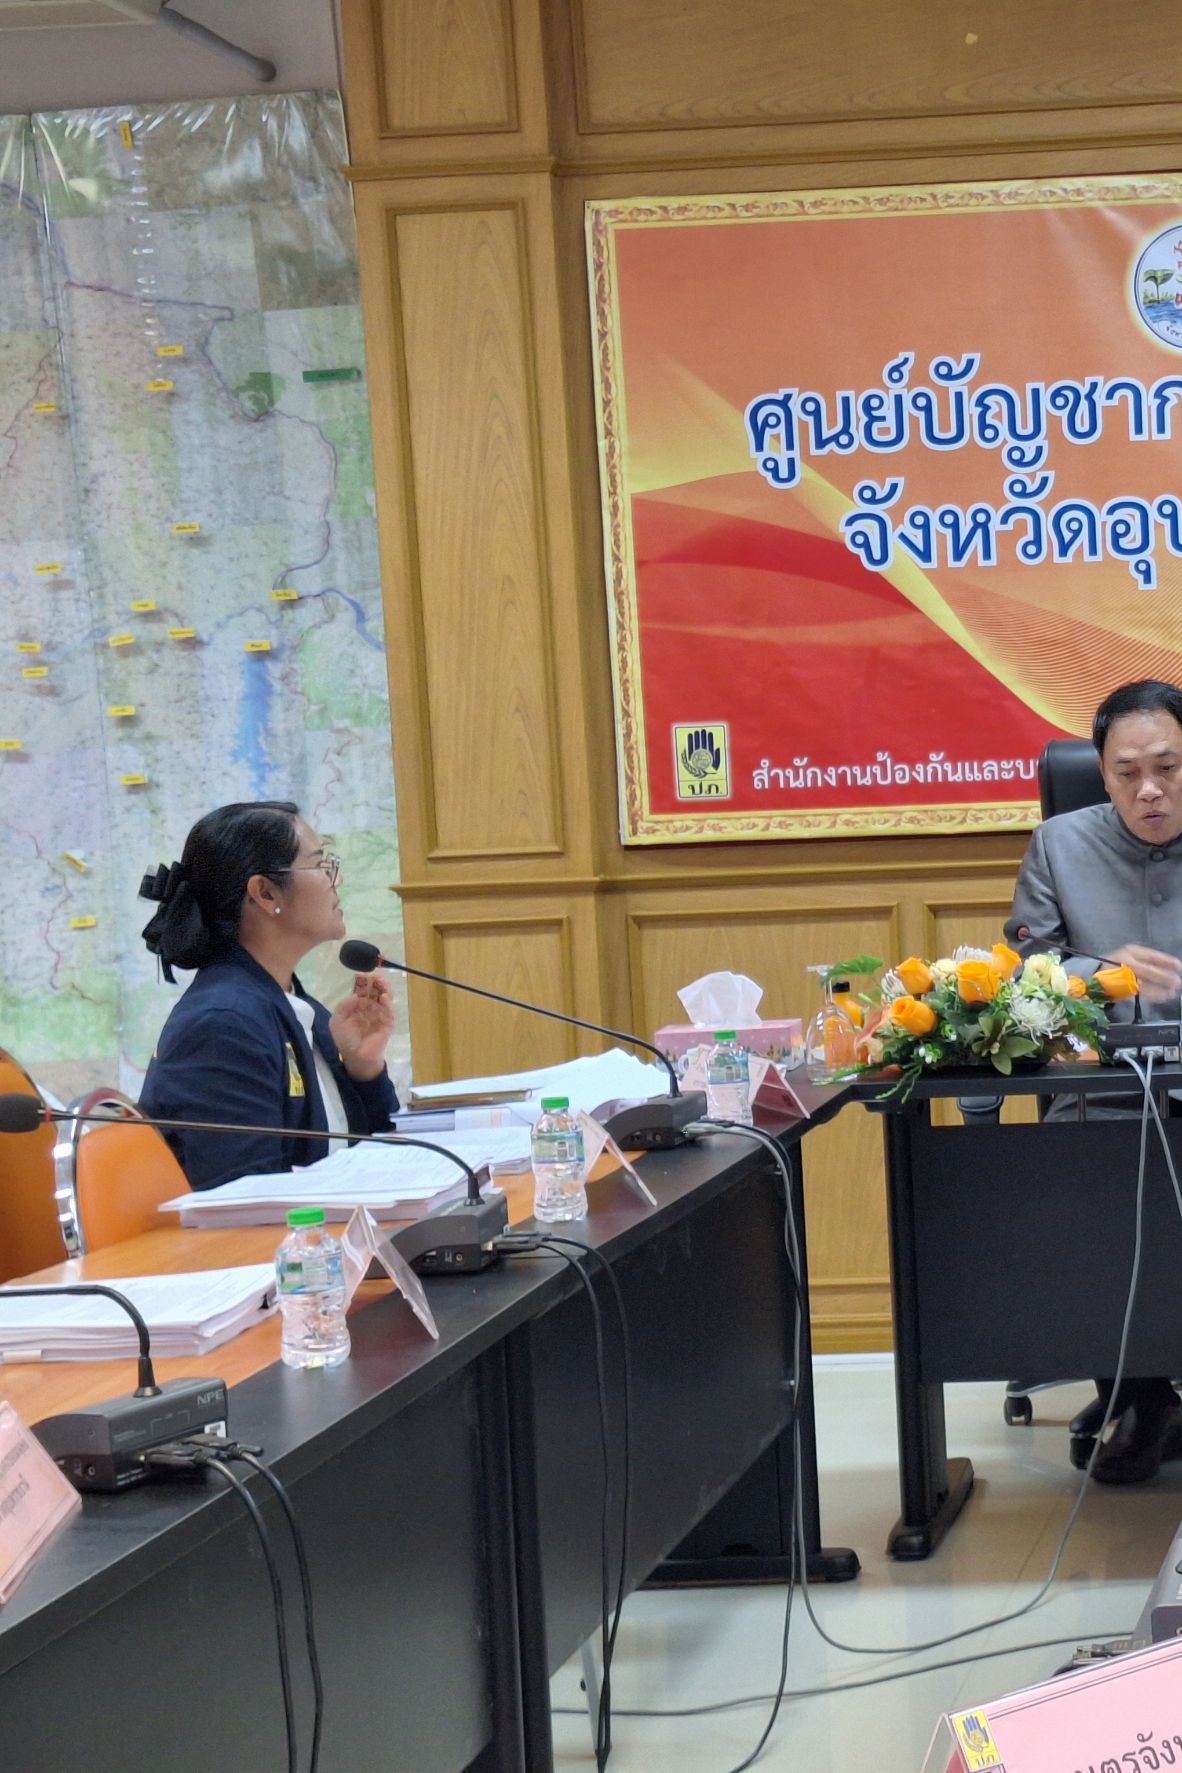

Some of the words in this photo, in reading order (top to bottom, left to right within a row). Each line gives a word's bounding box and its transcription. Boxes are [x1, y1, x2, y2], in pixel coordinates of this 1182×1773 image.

[752, 751, 1039, 791] สำนักงานป้องกันและบ
[196, 1388, 225, 1409] NPE
